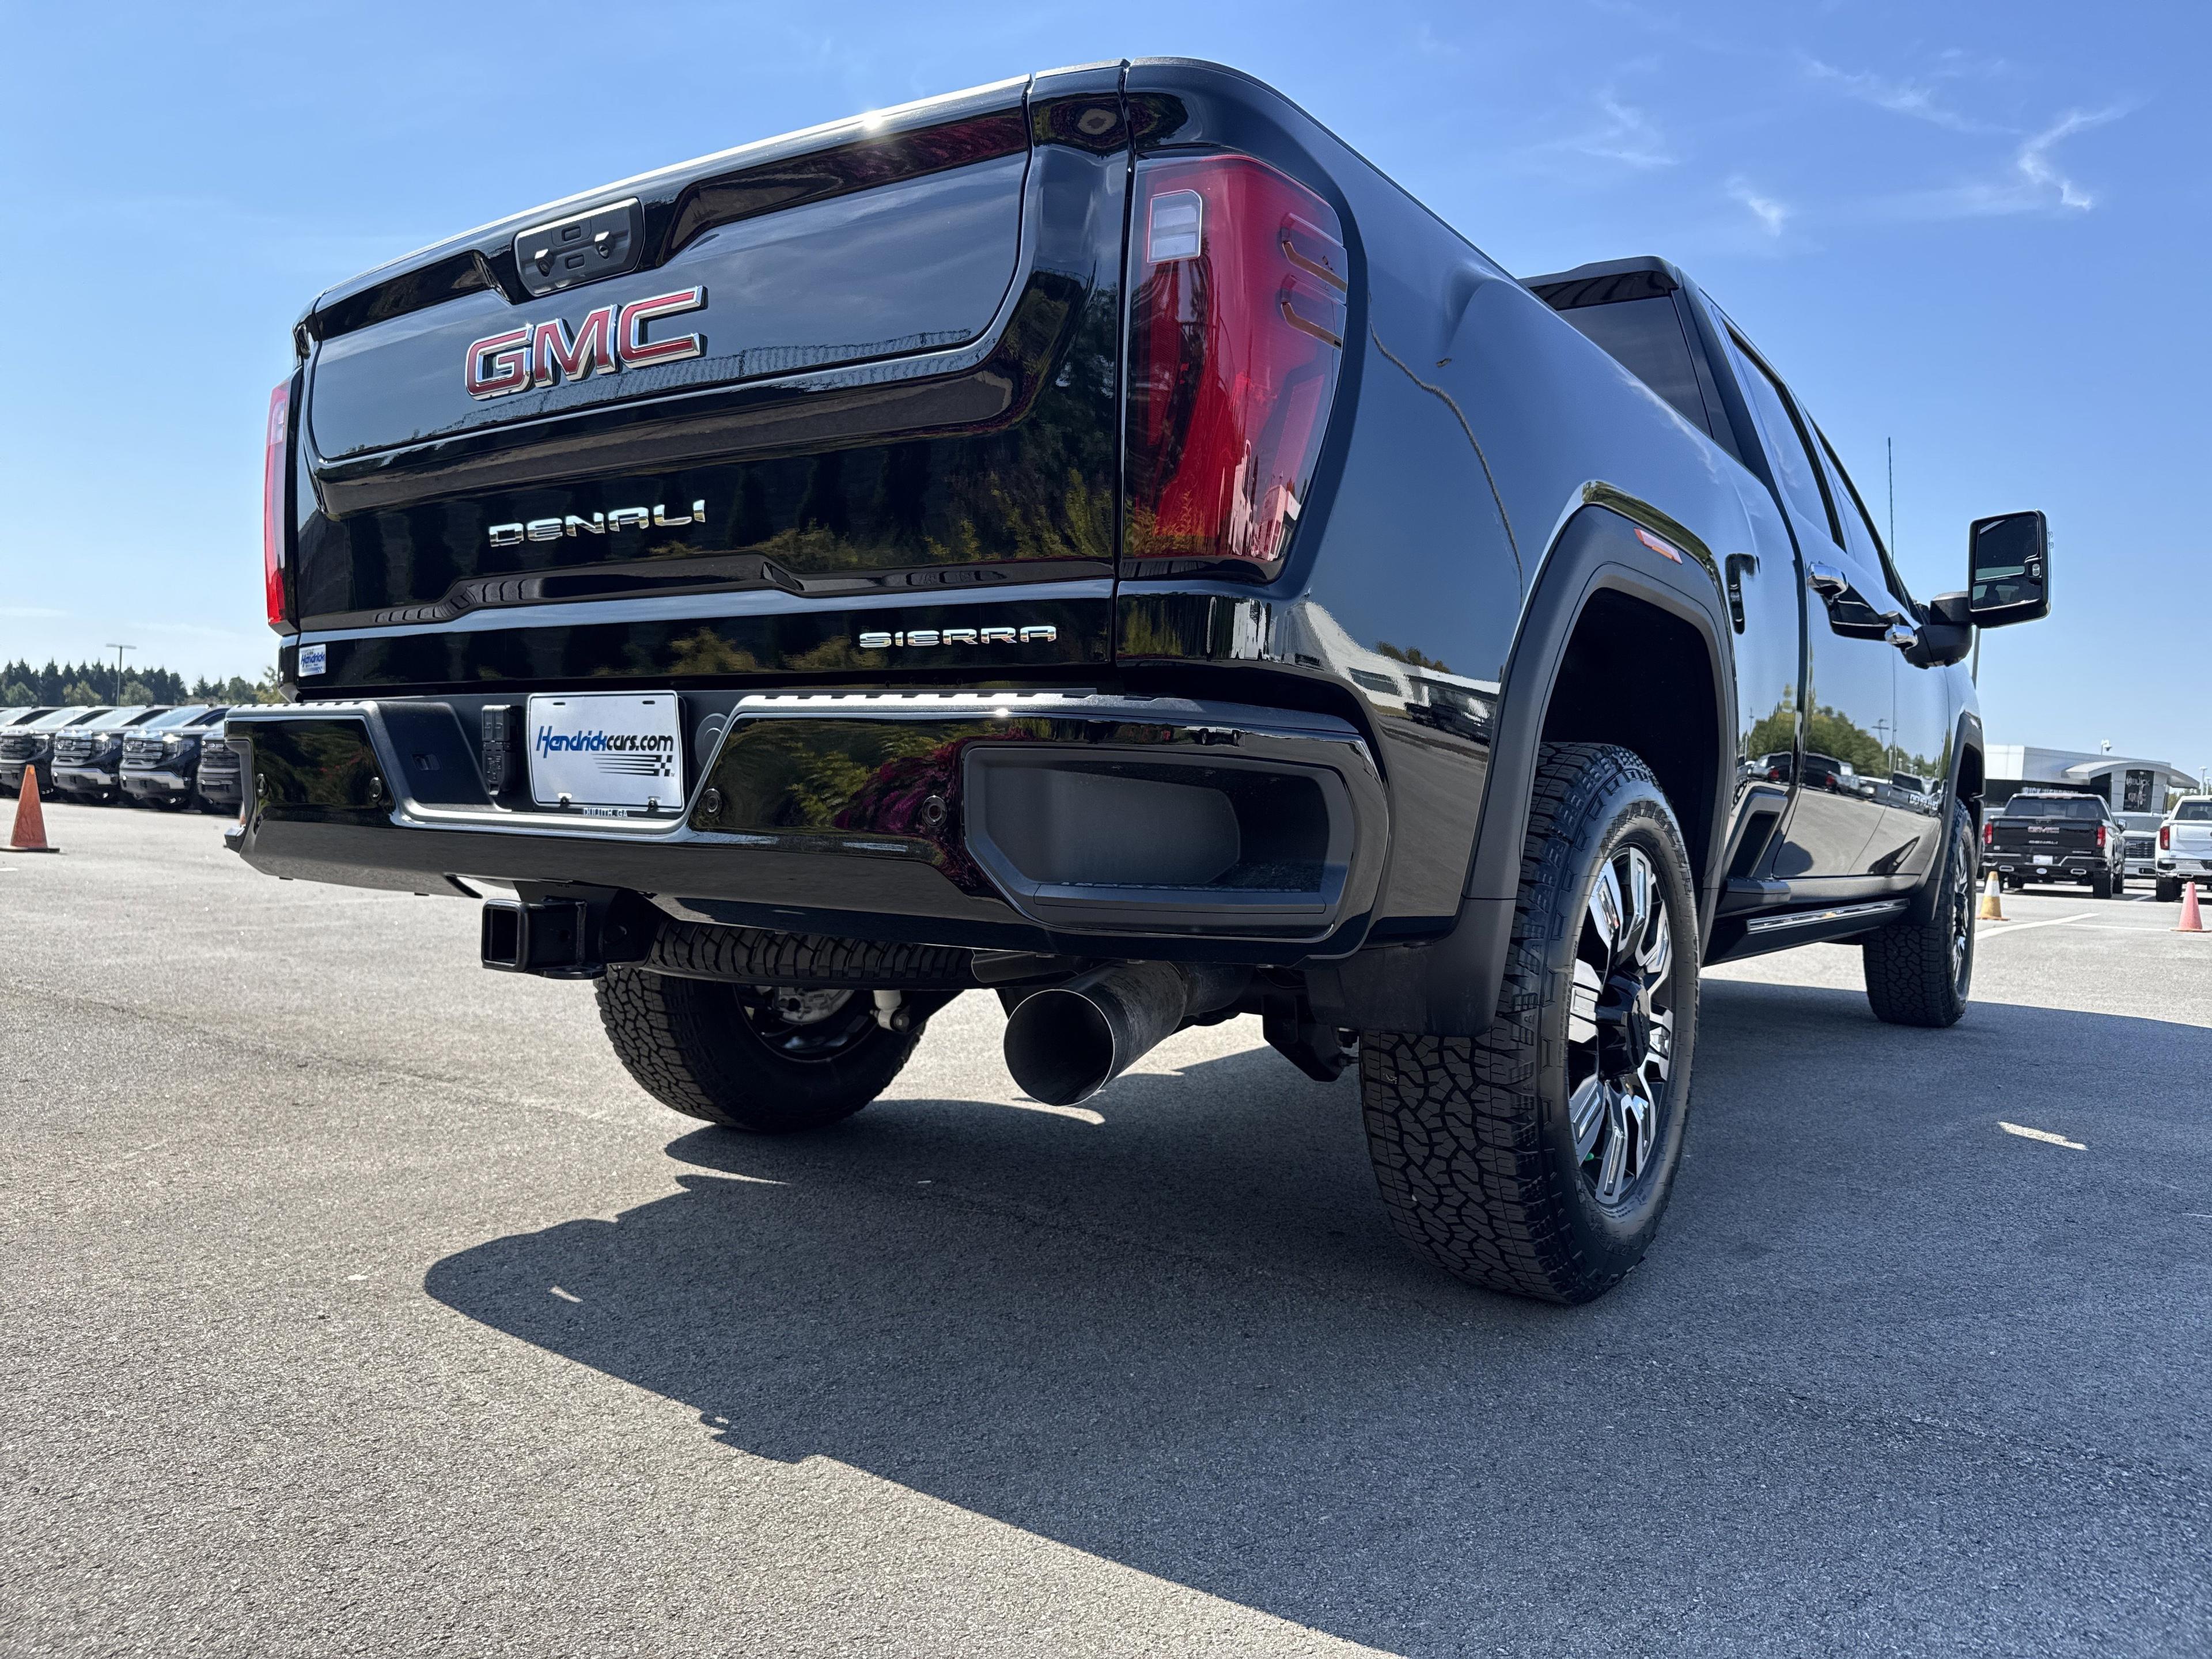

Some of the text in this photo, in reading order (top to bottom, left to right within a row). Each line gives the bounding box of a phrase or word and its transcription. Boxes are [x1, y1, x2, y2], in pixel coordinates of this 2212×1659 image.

[465, 285, 706, 401] GMC
[488, 499, 705, 548] DENALI
[859, 626, 1056, 647] SIERRA
[300, 652, 325, 668] Hendrick
[536, 725, 674, 759] Hendrickcars.com
[617, 808, 628, 818] GA
